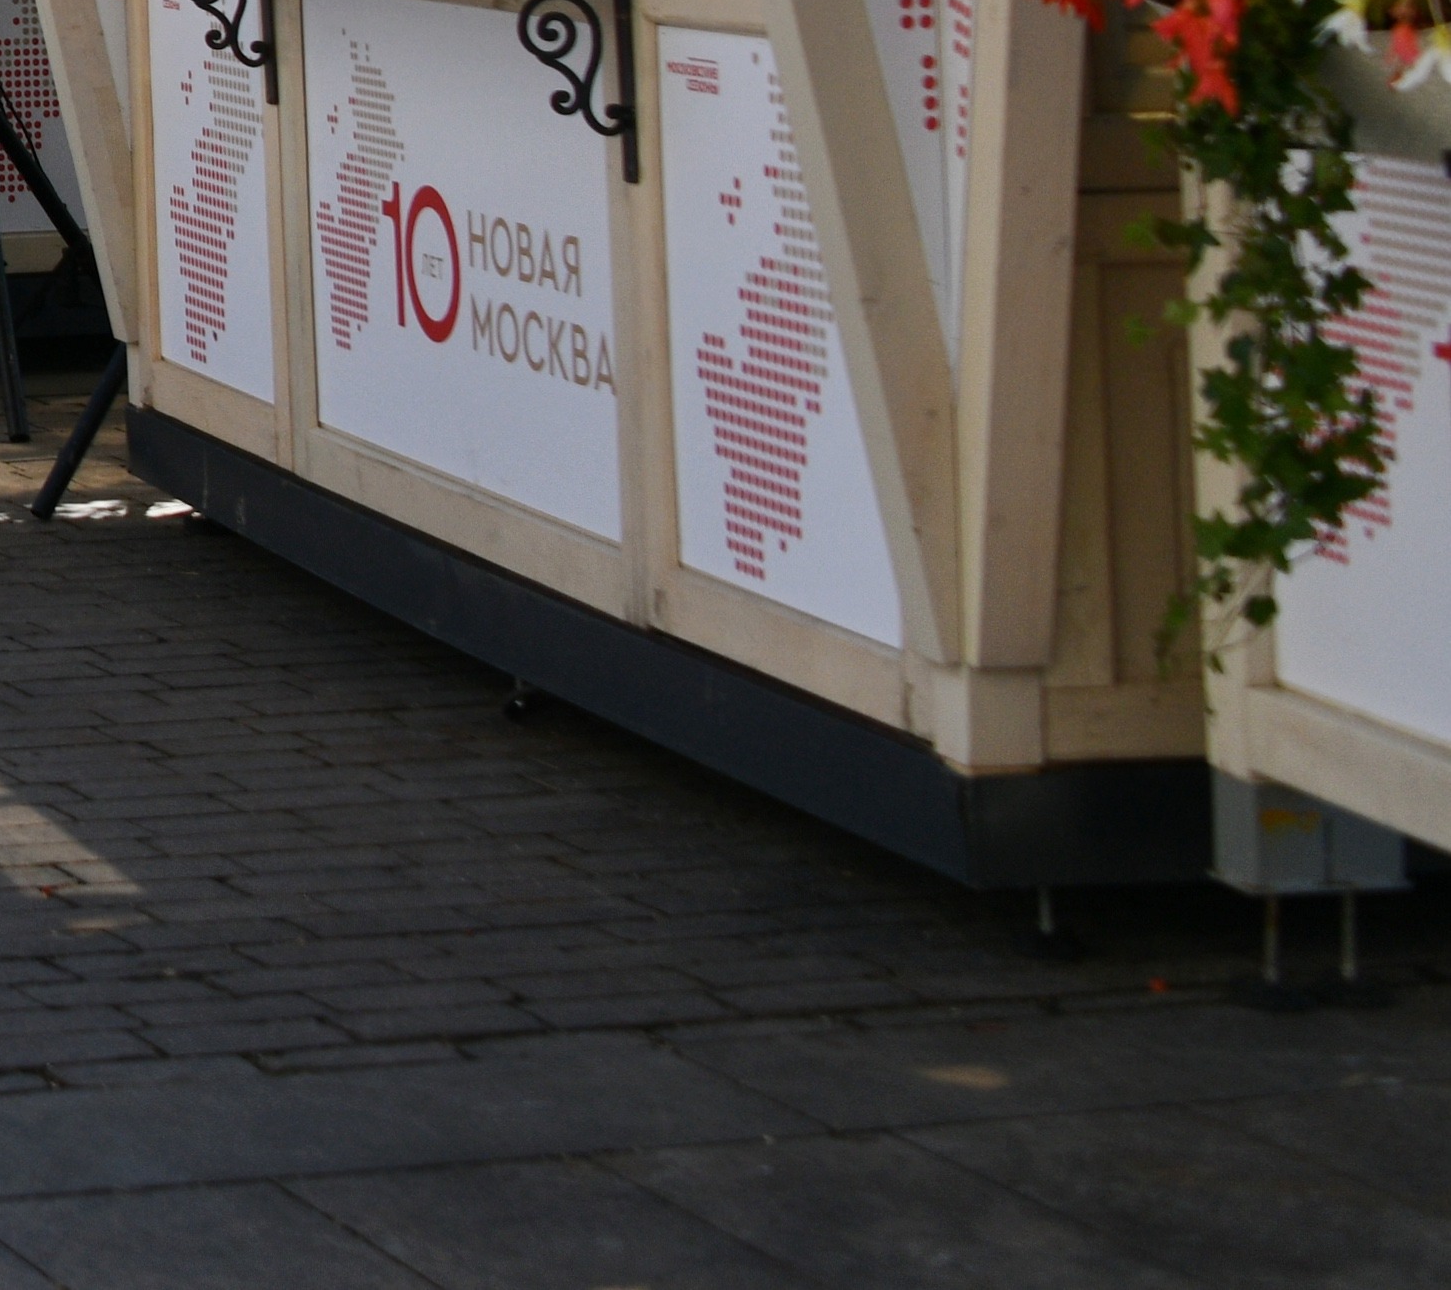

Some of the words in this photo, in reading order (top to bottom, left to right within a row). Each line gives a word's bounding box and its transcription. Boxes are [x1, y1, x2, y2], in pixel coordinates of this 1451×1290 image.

[382, 181, 461, 343] 10
[467, 210, 582, 297] НОВАЯ
[470, 293, 617, 396] МОСКВА
